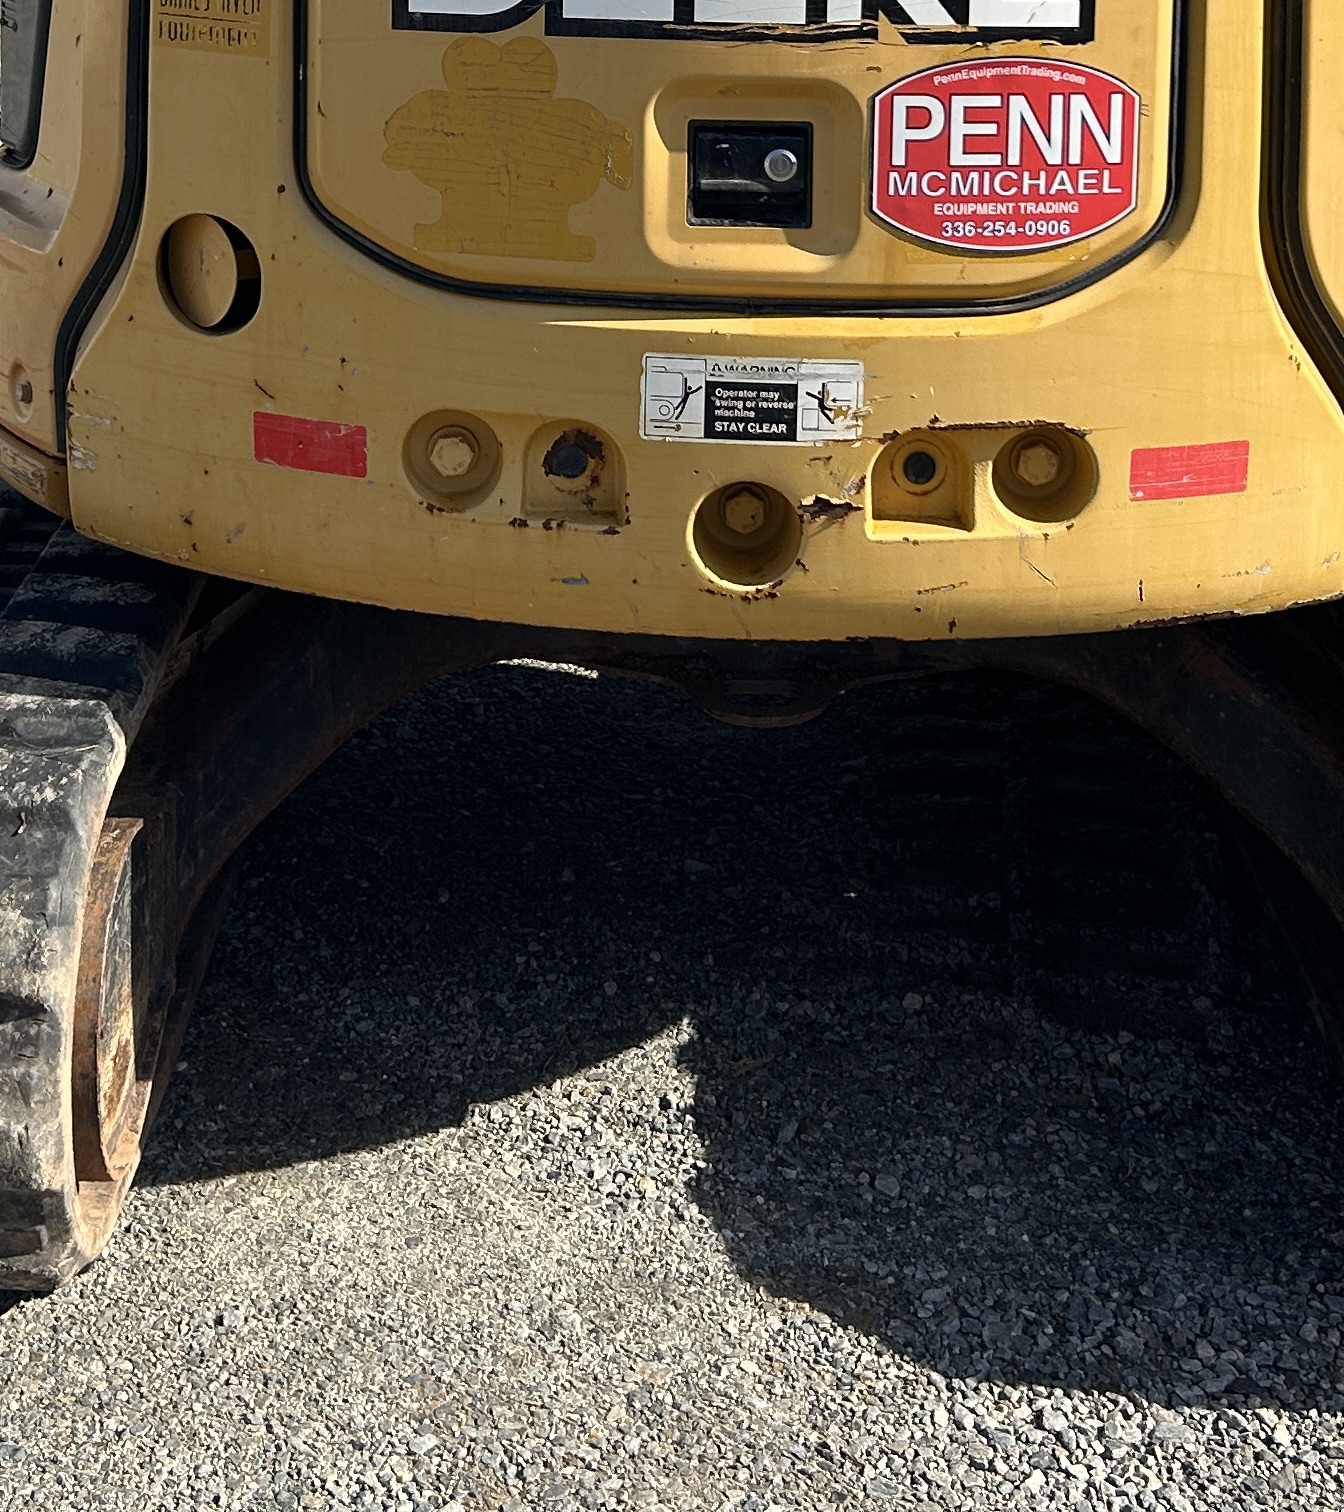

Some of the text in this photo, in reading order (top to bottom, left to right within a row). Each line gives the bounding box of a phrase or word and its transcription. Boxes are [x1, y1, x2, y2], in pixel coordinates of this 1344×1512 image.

[932, 64, 1086, 86] PennEquipmentTrading.com
[891, 93, 1124, 166] PENN
[888, 169, 1123, 197] MCMICHAEL
[933, 201, 1079, 216] EQUIPMENT TRADING
[941, 219, 1071, 237] 336-254-0906
[715, 388, 780, 401] Operator may
[745, 400, 757, 408] or
[714, 421, 787, 434] STAY CLEAR
